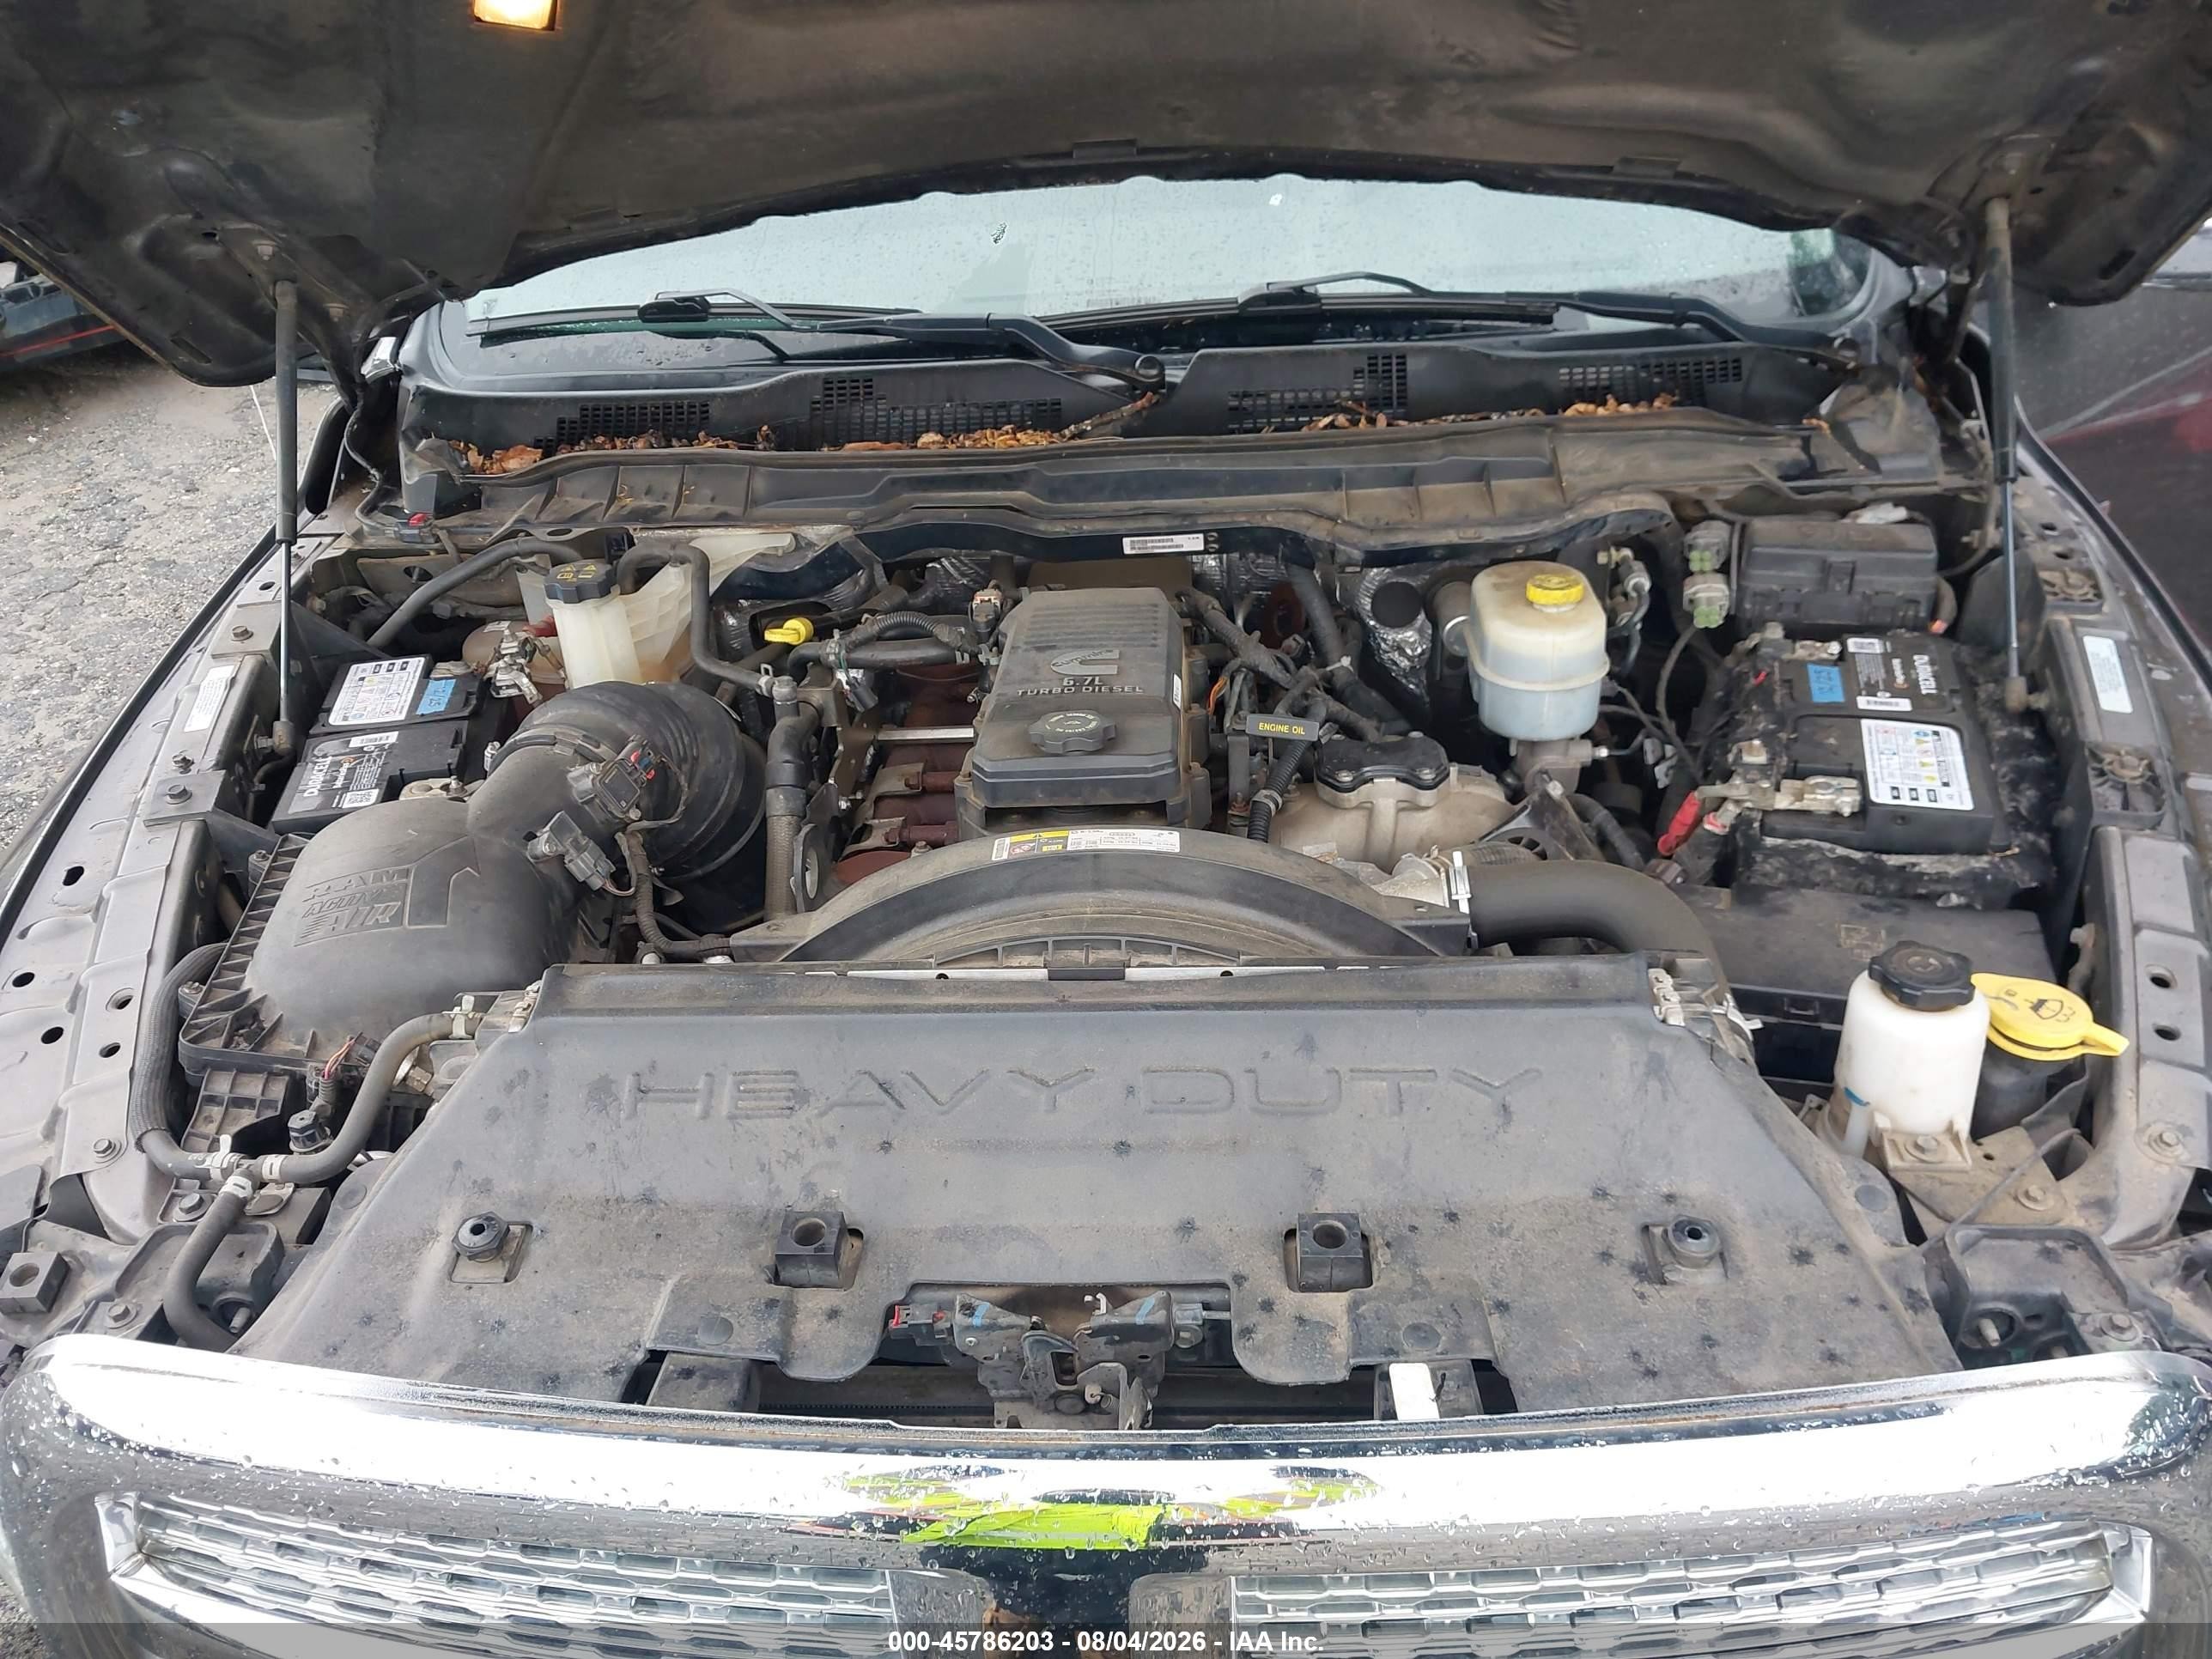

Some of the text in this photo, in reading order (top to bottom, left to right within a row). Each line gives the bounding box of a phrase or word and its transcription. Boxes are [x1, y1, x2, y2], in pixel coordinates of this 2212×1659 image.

[1017, 685, 1144, 696] TURBO DIESEL
[1063, 677, 1103, 686] 6.7L
[1912, 654, 1938, 695] DURACELL
[1258, 722, 1305, 735] ENGINE OIL
[303, 755, 333, 798] DURACELL
[326, 901, 402, 933] AIR
[621, 1066, 1544, 1117] HEAVY DUTY
